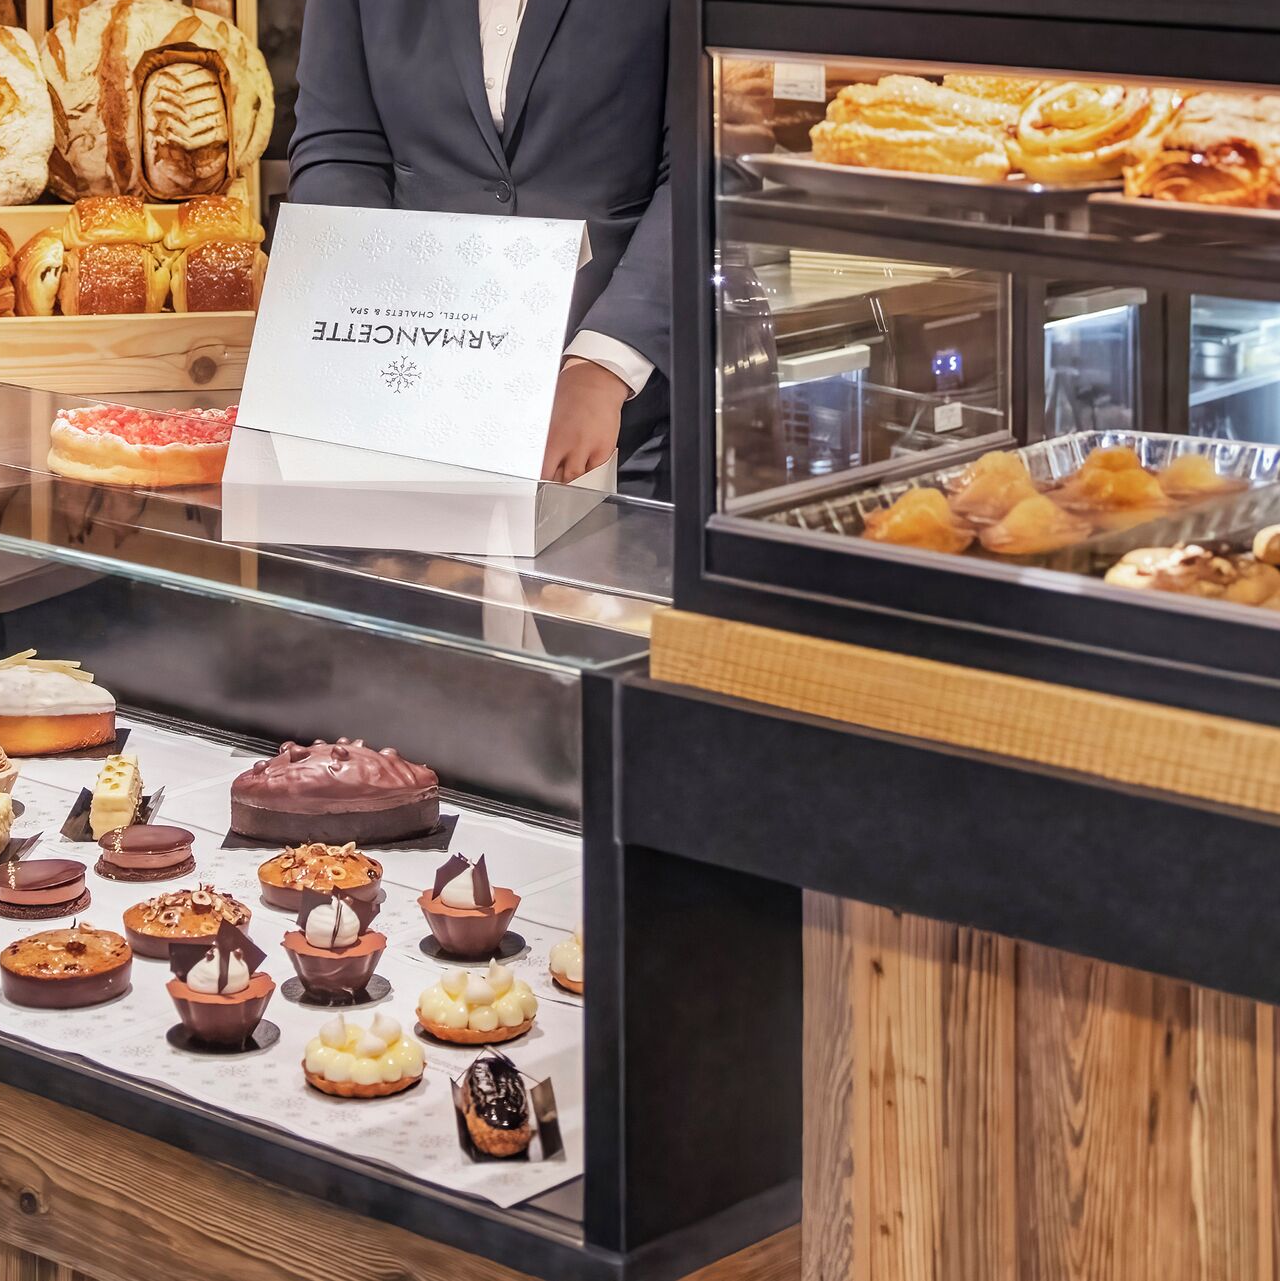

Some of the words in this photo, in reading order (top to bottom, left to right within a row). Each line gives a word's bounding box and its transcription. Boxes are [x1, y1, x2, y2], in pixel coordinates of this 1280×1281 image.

[349, 306, 369, 315] SPA
[373, 308, 381, 316] &
[385, 309, 434, 319] CHALETS
[439, 311, 478, 321] HÔTEL,
[312, 320, 509, 350] ARMANCETTE
